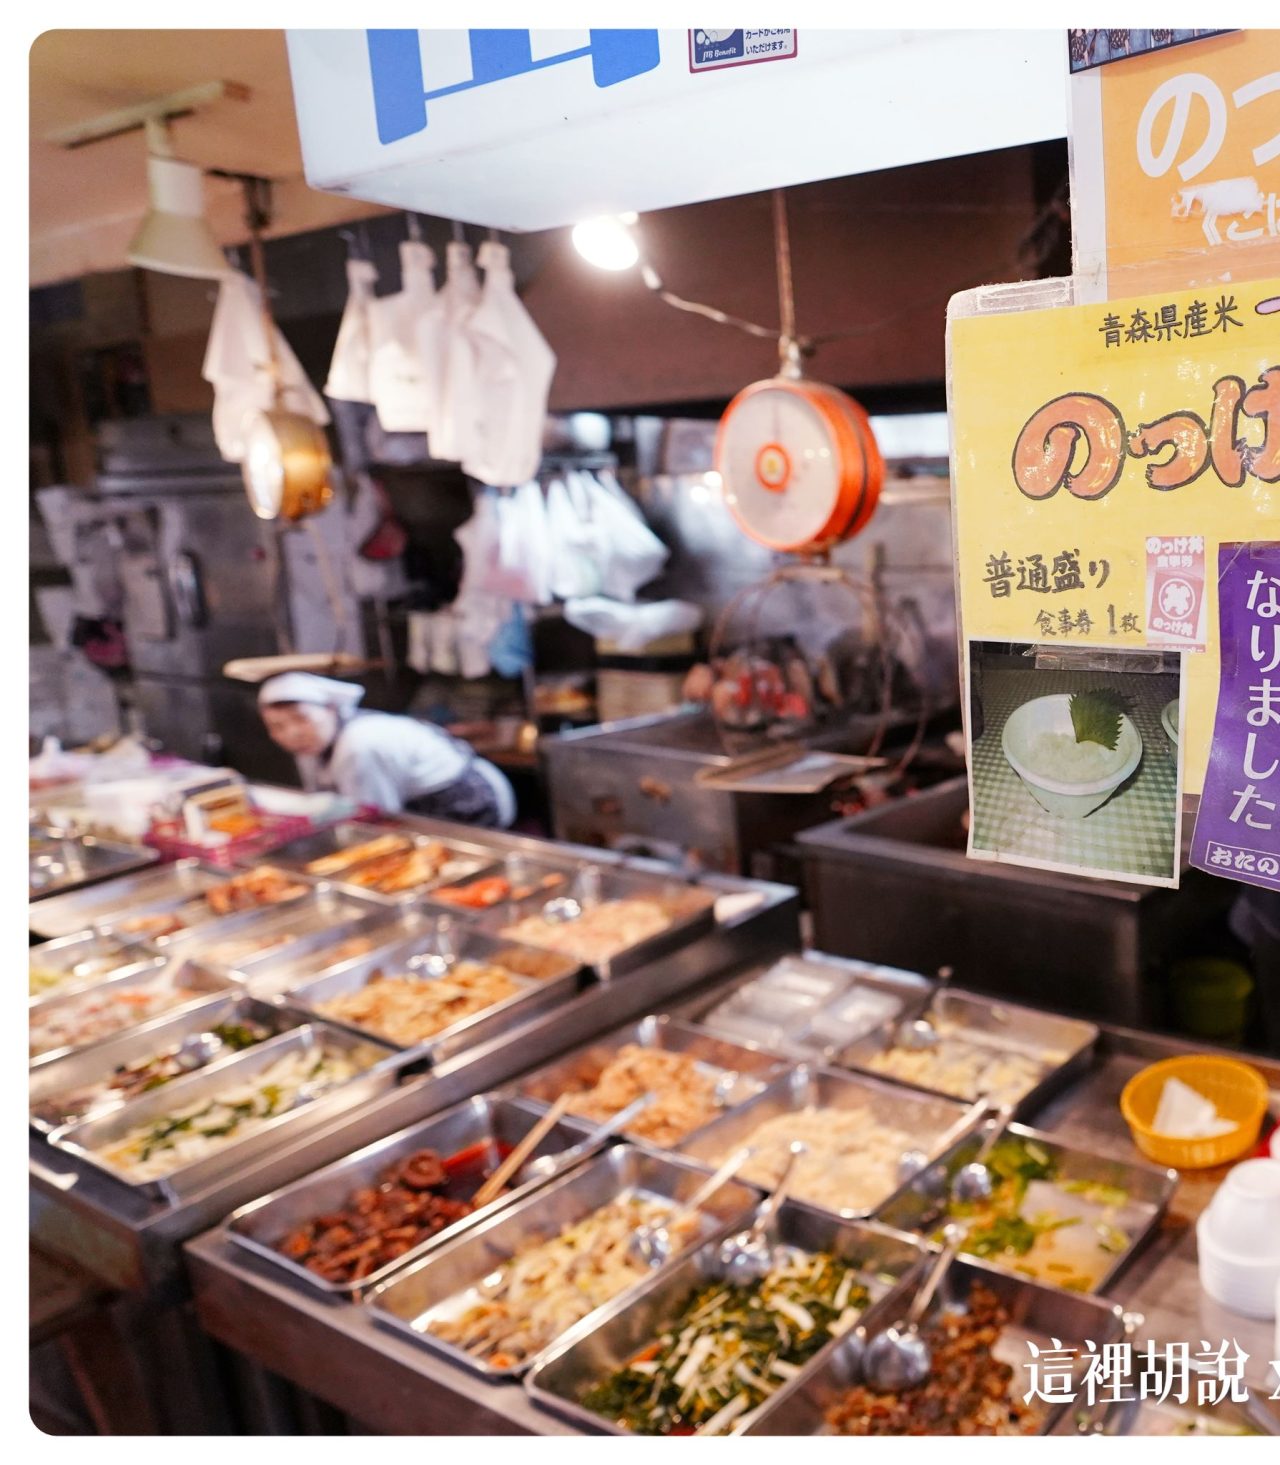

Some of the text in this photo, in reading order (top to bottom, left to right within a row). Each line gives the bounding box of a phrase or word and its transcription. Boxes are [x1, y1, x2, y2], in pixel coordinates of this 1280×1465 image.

[1098, 295, 1246, 349] 青森県産米
[982, 548, 1110, 598] 普通盛り
